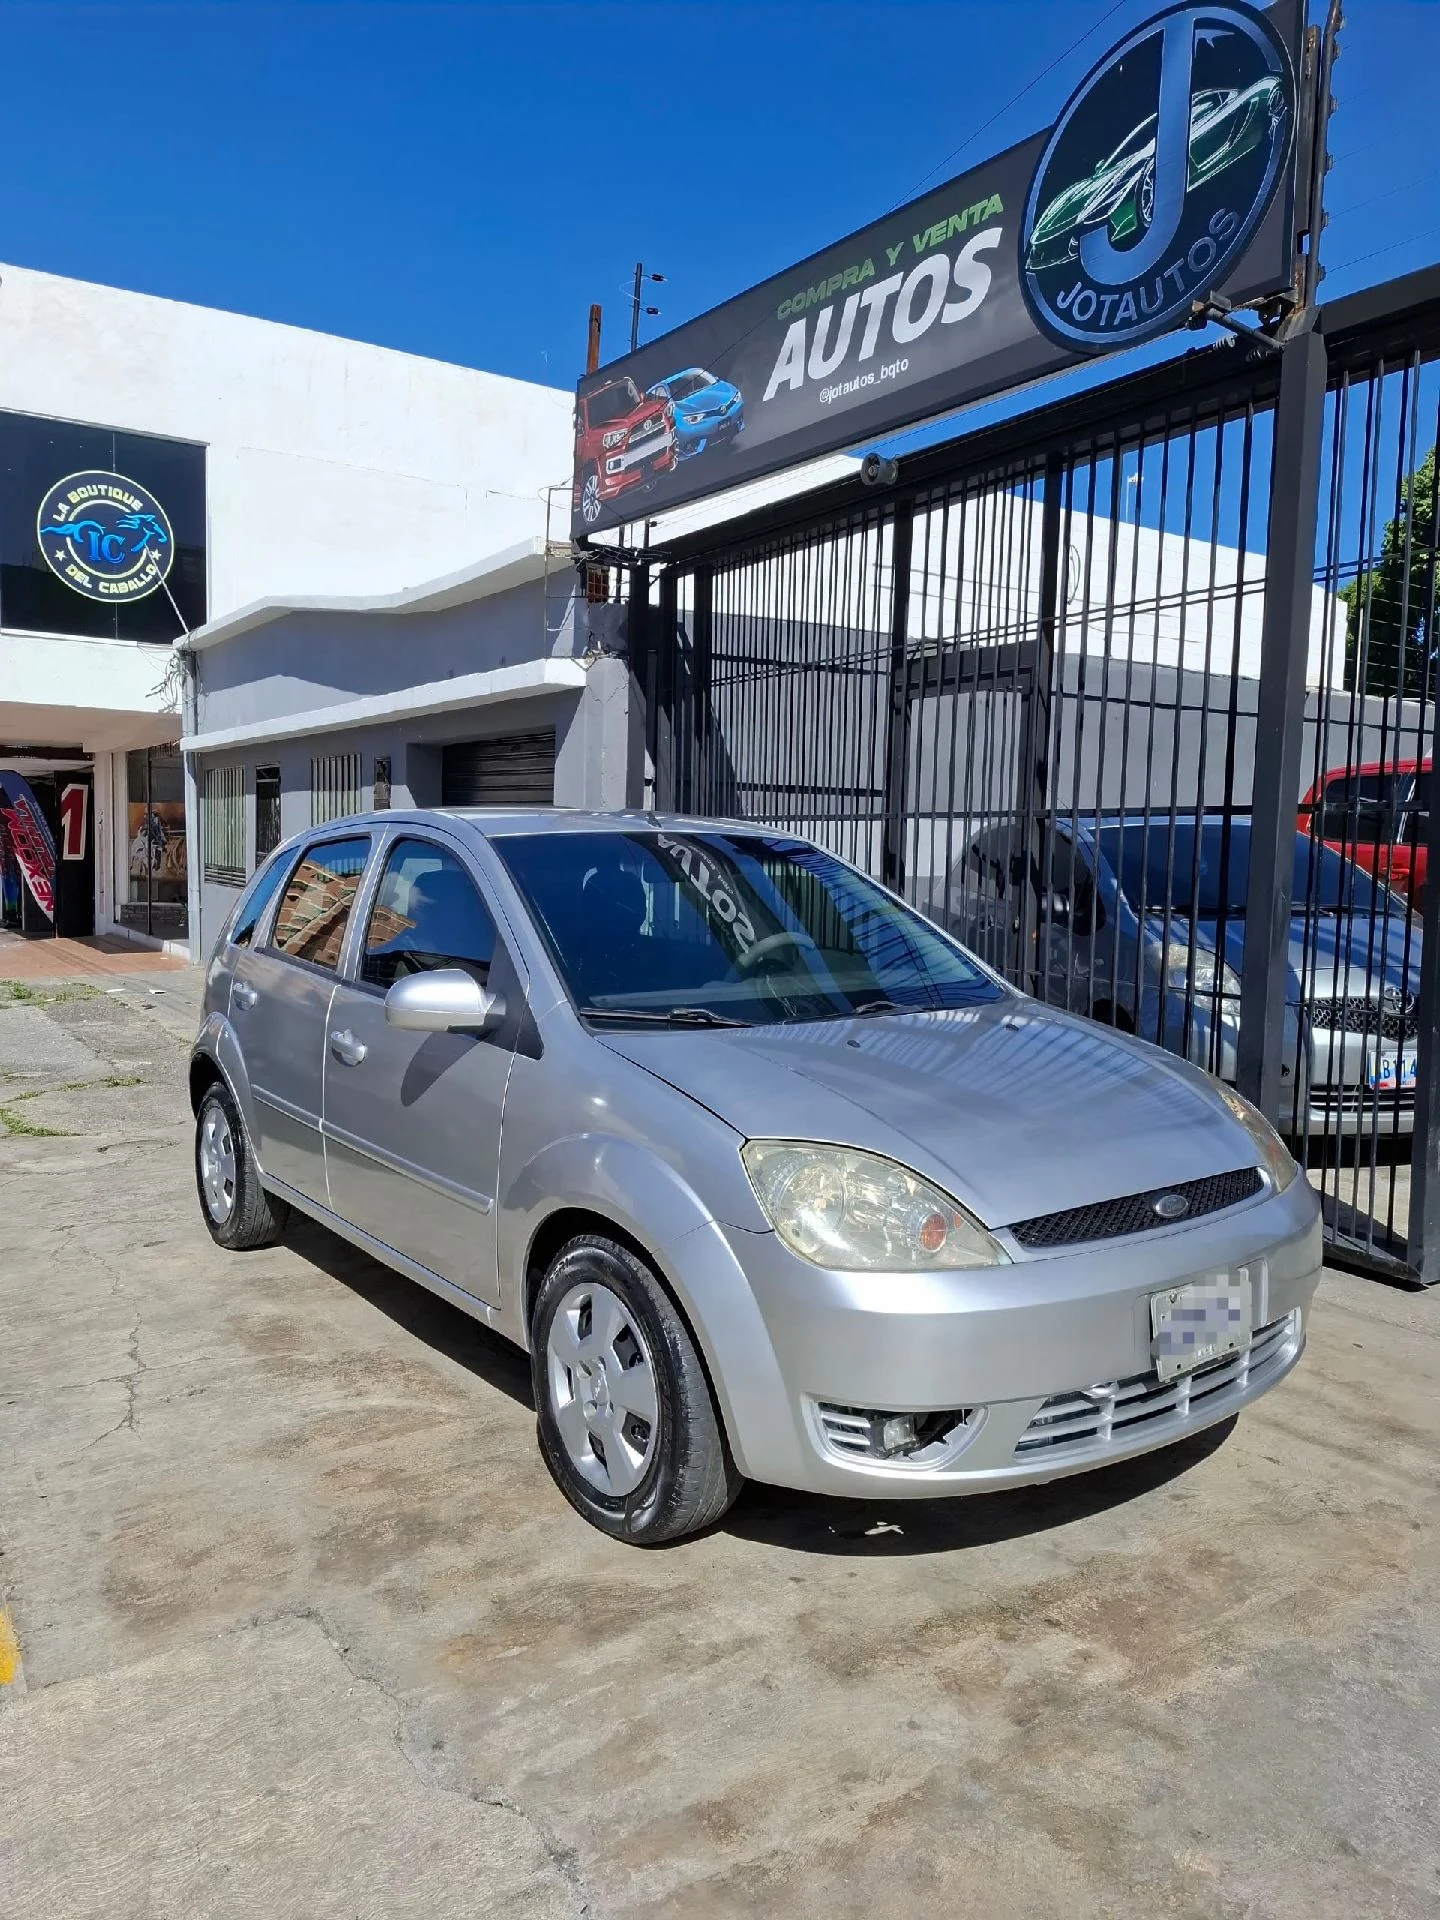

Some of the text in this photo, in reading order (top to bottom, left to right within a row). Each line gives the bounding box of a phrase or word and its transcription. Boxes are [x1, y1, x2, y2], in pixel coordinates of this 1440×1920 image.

[777, 193, 1004, 321] COMPRA Y VENTA
[1056, 207, 1240, 326] JOTAUTOS
[762, 227, 1003, 402] AUTOS
[819, 357, 909, 404] @jotautos_bqto
[53, 484, 144, 522] LA BOUTIQUE
[65, 563, 157, 594] DEL CABALLO
